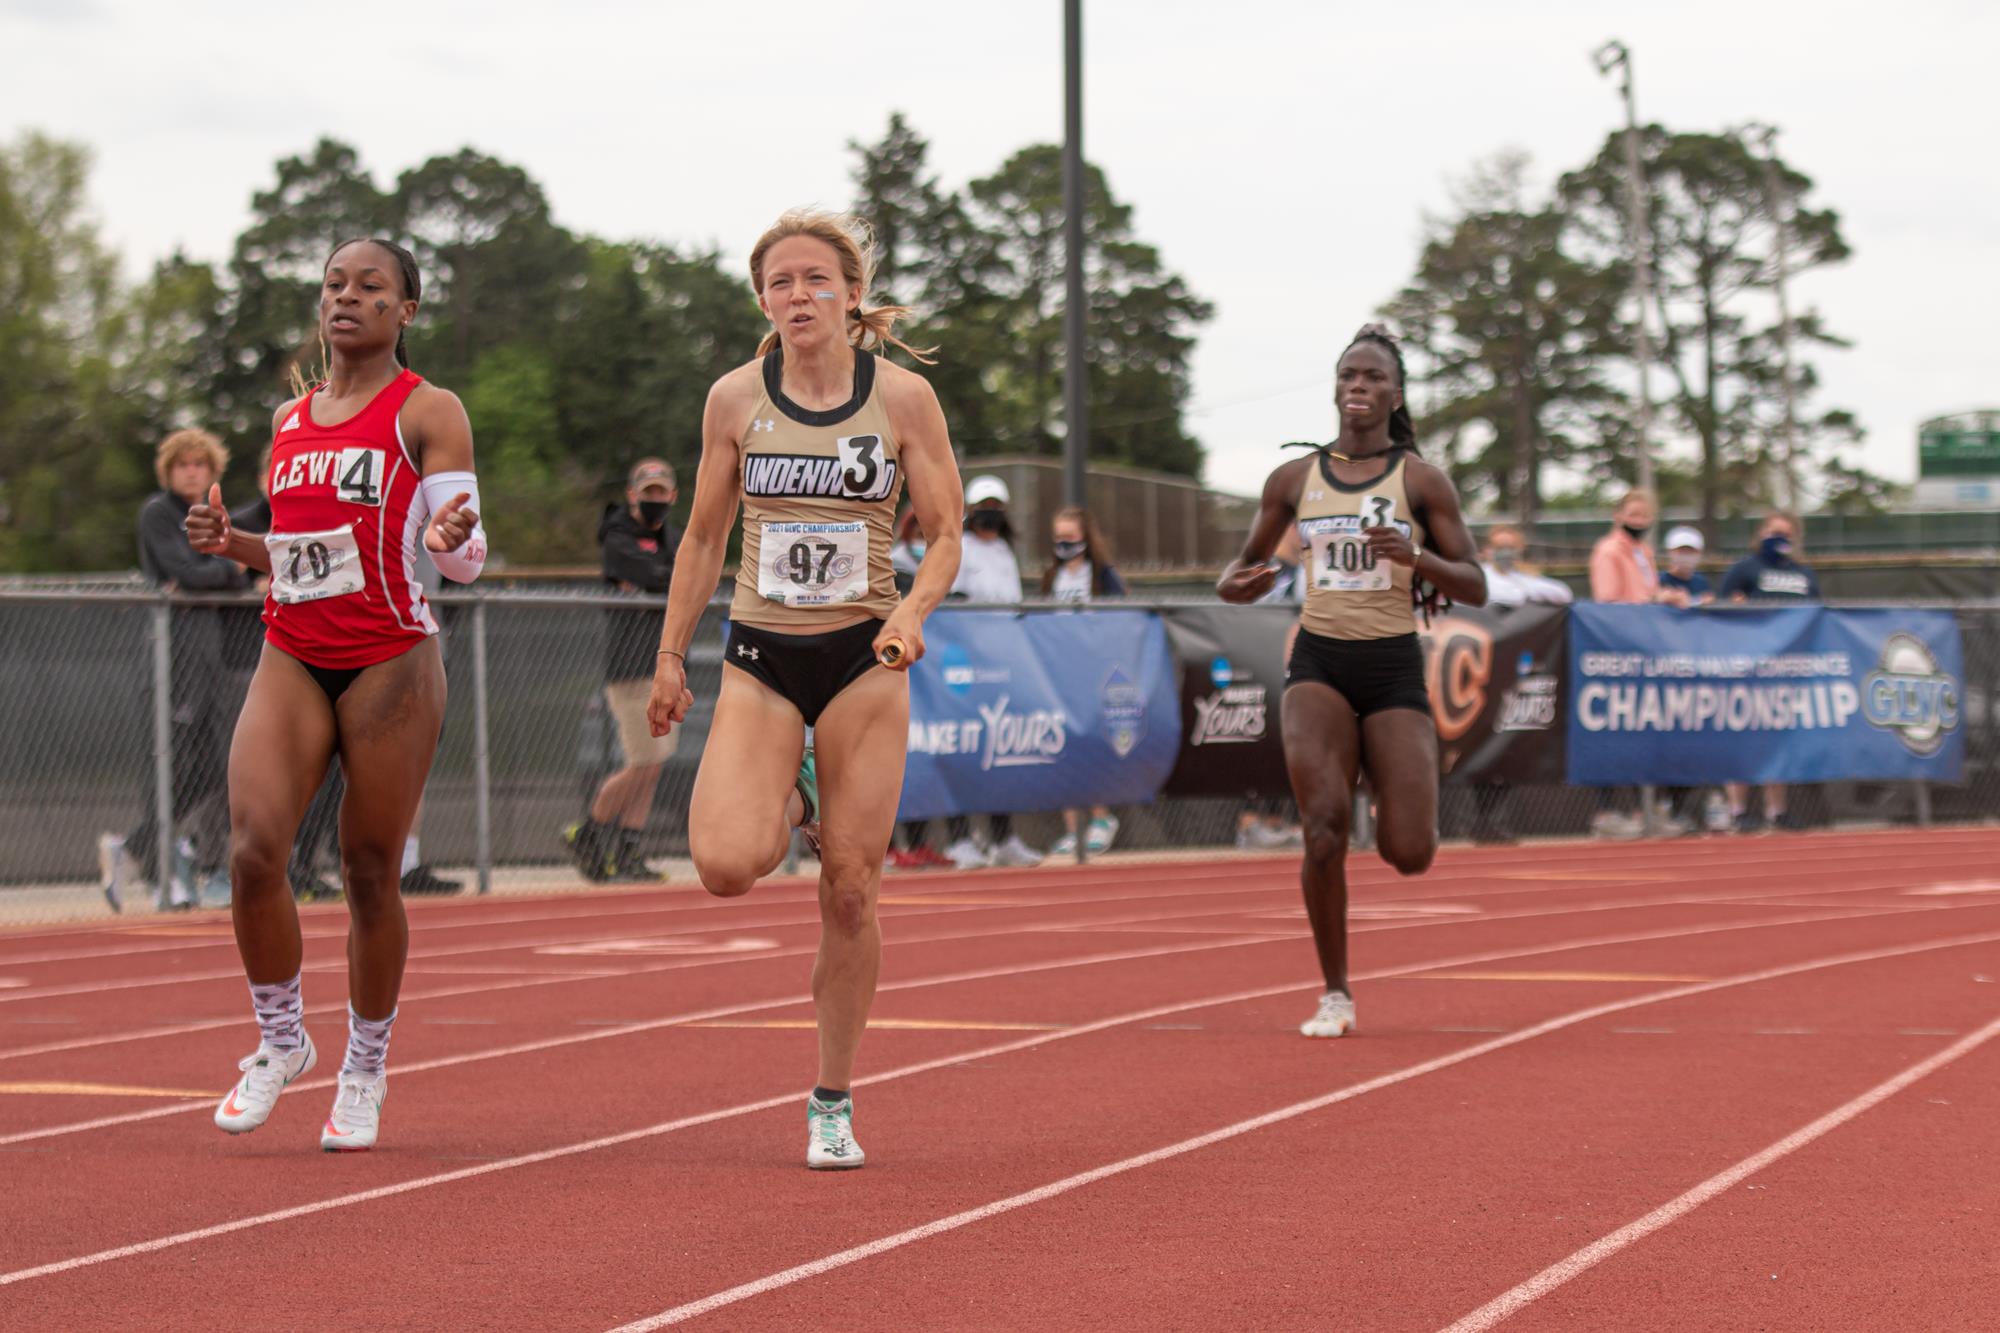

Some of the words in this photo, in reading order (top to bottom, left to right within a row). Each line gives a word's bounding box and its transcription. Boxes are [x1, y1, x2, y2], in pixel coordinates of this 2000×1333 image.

[272, 451, 342, 496] LEWI
[341, 450, 379, 505] 4
[745, 457, 896, 499] LINDENWD
[844, 435, 878, 493] 3
[803, 523, 861, 533] CHAMPIONSHIPS
[1361, 496, 1391, 531] 3
[289, 542, 330, 584] 70
[789, 543, 837, 584] 97
[1326, 541, 1376, 571] 100
[1580, 652, 1642, 677] GREAT
[1191, 690, 1267, 746] YOURS
[1578, 682, 1859, 731] CHAMPIONSHIP
[959, 720, 981, 753] IT
[977, 694, 1066, 772] YOURS
